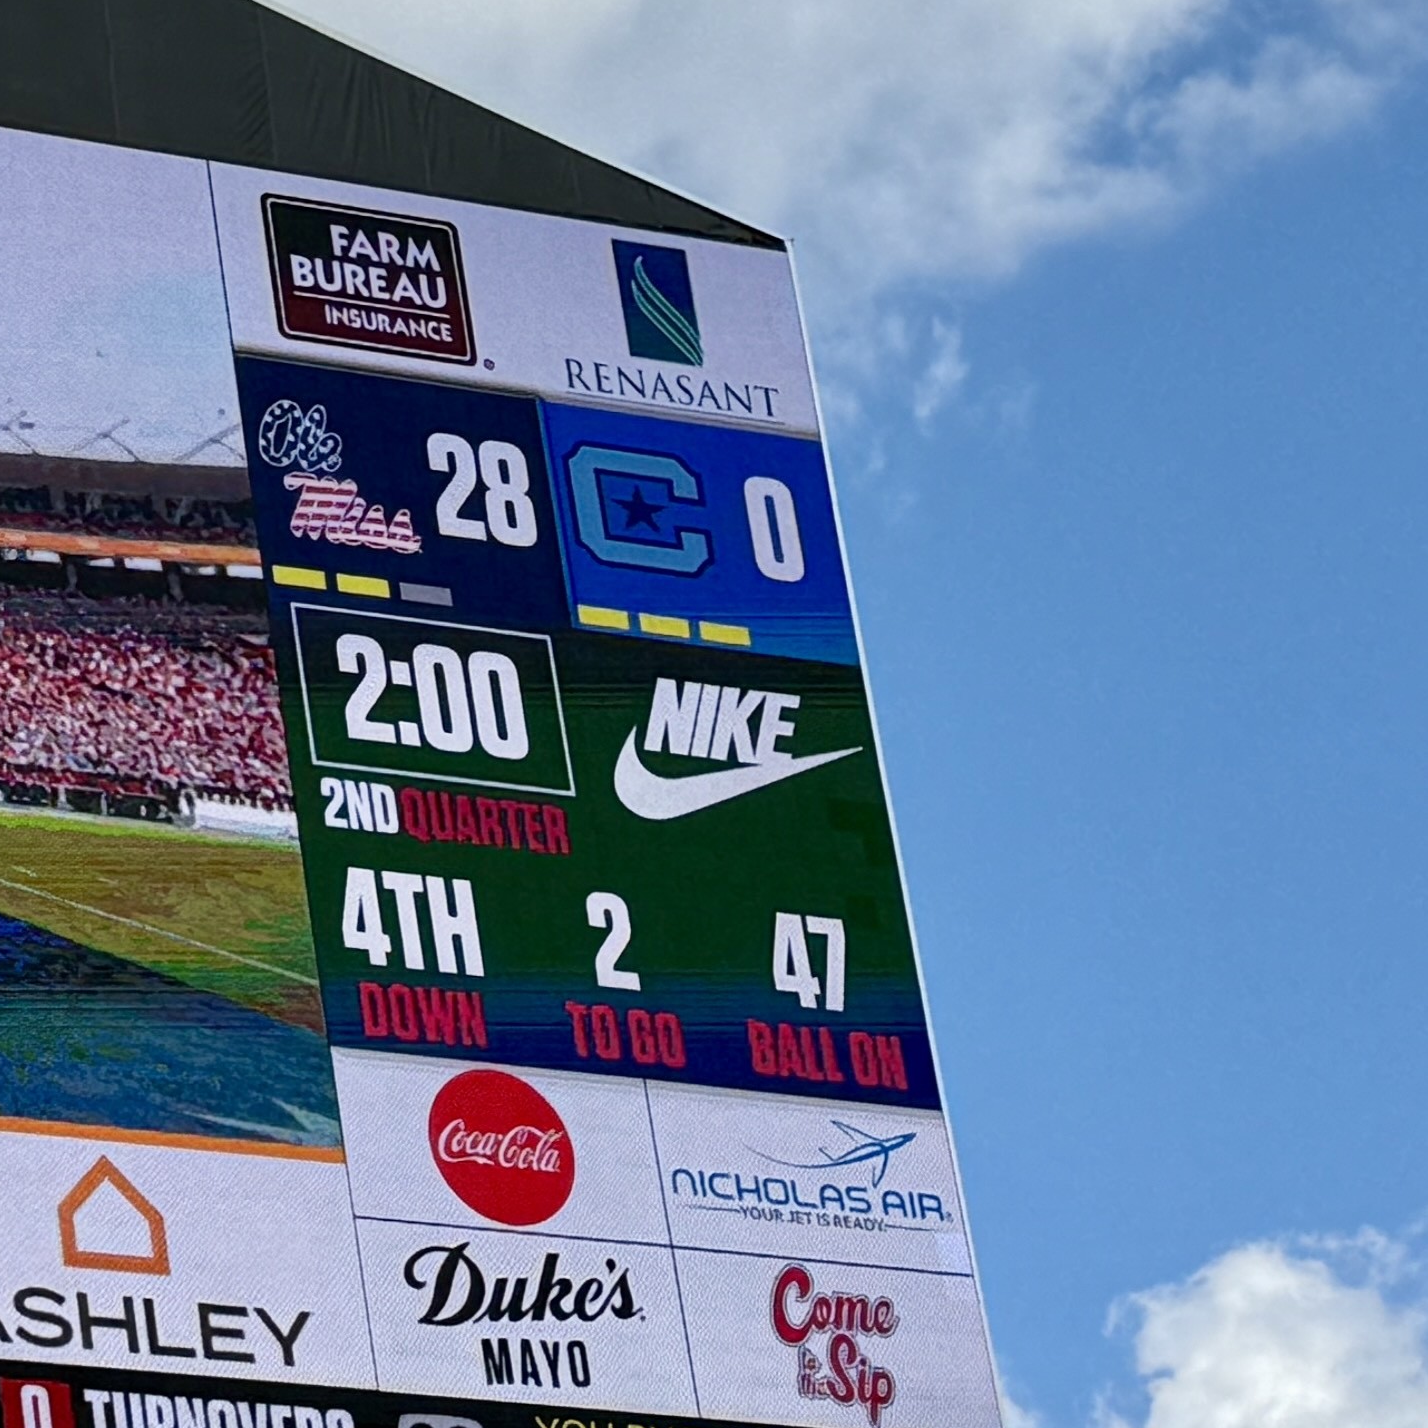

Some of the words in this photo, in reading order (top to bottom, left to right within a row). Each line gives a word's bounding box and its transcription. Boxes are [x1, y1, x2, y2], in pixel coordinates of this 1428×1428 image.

[290, 254, 447, 310] BUREAU
[330, 225, 441, 273] FARM
[324, 303, 454, 344] INSURANCE
[565, 358, 780, 419] RENASANT
[427, 432, 538, 548] 28
[743, 475, 805, 583] 0
[336, 633, 529, 760] 2:00
[644, 676, 801, 765] NIKE
[320, 777, 399, 834] 2ND
[398, 787, 571, 855] QUARTER
[341, 865, 485, 978] 4TH
[585, 891, 642, 992] 2
[772, 911, 845, 1013] 47
[358, 980, 488, 1049] DOWN
[566, 1000, 620, 1060] TO
[628, 1009, 686, 1068] GO
[747, 1018, 845, 1082] BALL
[850, 1031, 908, 1090] ON
[437, 1118, 564, 1173] Coca-Cola
[671, 1168, 873, 1214] NICHOLAS
[881, 1189, 945, 1222] AIR
[739, 1205, 784, 1223] YOUR
[786, 1210, 812, 1227] JET
[815, 1213, 832, 1227] IS
[404, 1241, 639, 1328] Duke's
[771, 1262, 900, 1347] Come
[481, 1337, 591, 1389] MAYO
